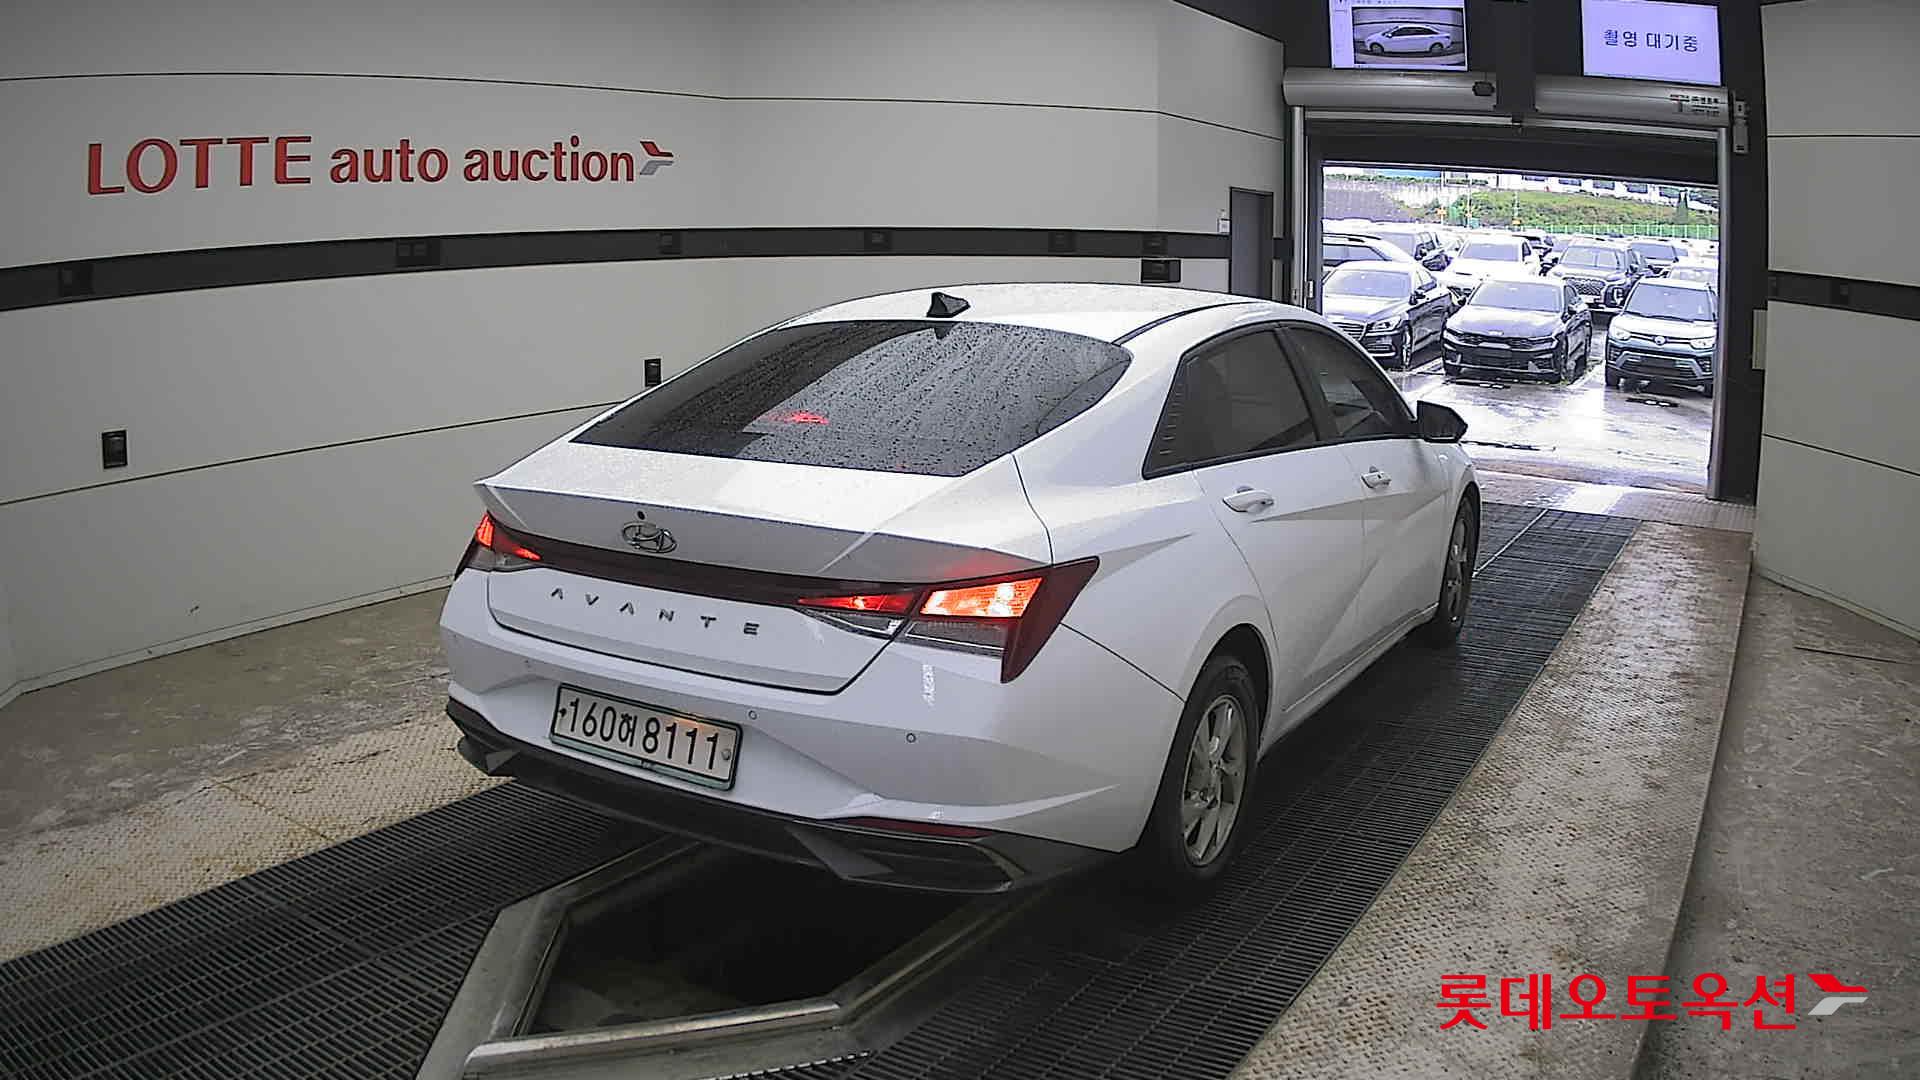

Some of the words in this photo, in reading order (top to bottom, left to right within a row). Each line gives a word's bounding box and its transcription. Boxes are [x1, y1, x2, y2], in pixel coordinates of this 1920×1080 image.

[1646, 32, 1698, 52] 대기중
[87, 135, 312, 195] LOTTE
[329, 138, 449, 184] auto
[463, 135, 635, 183] auction
[550, 587, 760, 636] AVANTE
